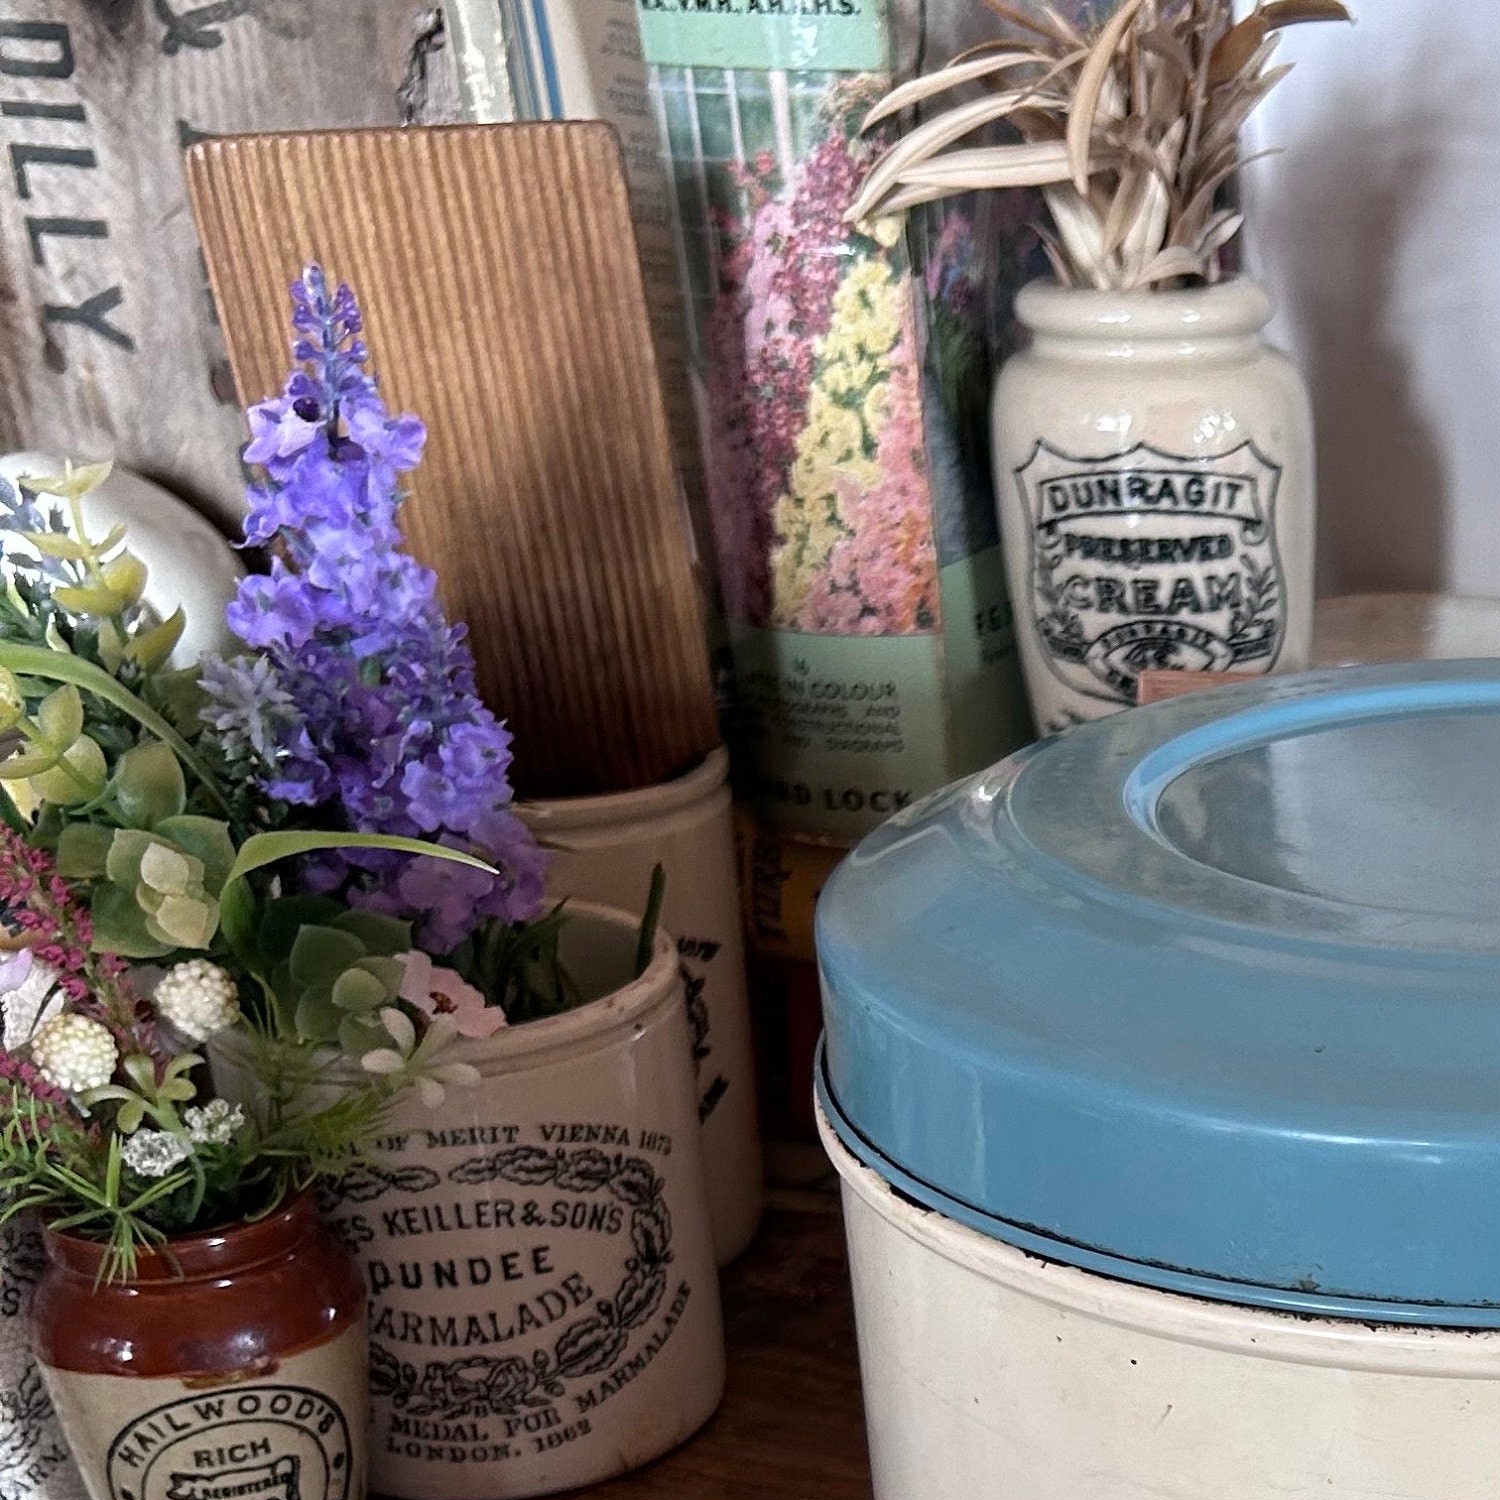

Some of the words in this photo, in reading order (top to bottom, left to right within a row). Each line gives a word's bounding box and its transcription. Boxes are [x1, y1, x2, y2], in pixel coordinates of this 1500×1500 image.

[1049, 476, 1245, 513] DUNRAGIT
[1064, 533, 1234, 564] PRESERVED
[1061, 571, 1244, 616] CREAM
[810, 681, 897, 702] COLOUR
[822, 787, 914, 814] LOCK
[426, 1125, 519, 1149] MERIT
[541, 1123, 631, 1147] VIENNA
[368, 1245, 556, 1297] DUNDEE
[388, 1411, 490, 1443] MEDAL
[504, 1407, 563, 1440] FOR
[573, 1277, 693, 1415] MARMALADE
[118, 1393, 336, 1468] HAILWOOD'S
[194, 1436, 272, 1469] RICH
[202, 1472, 291, 1499] REGISTERED
